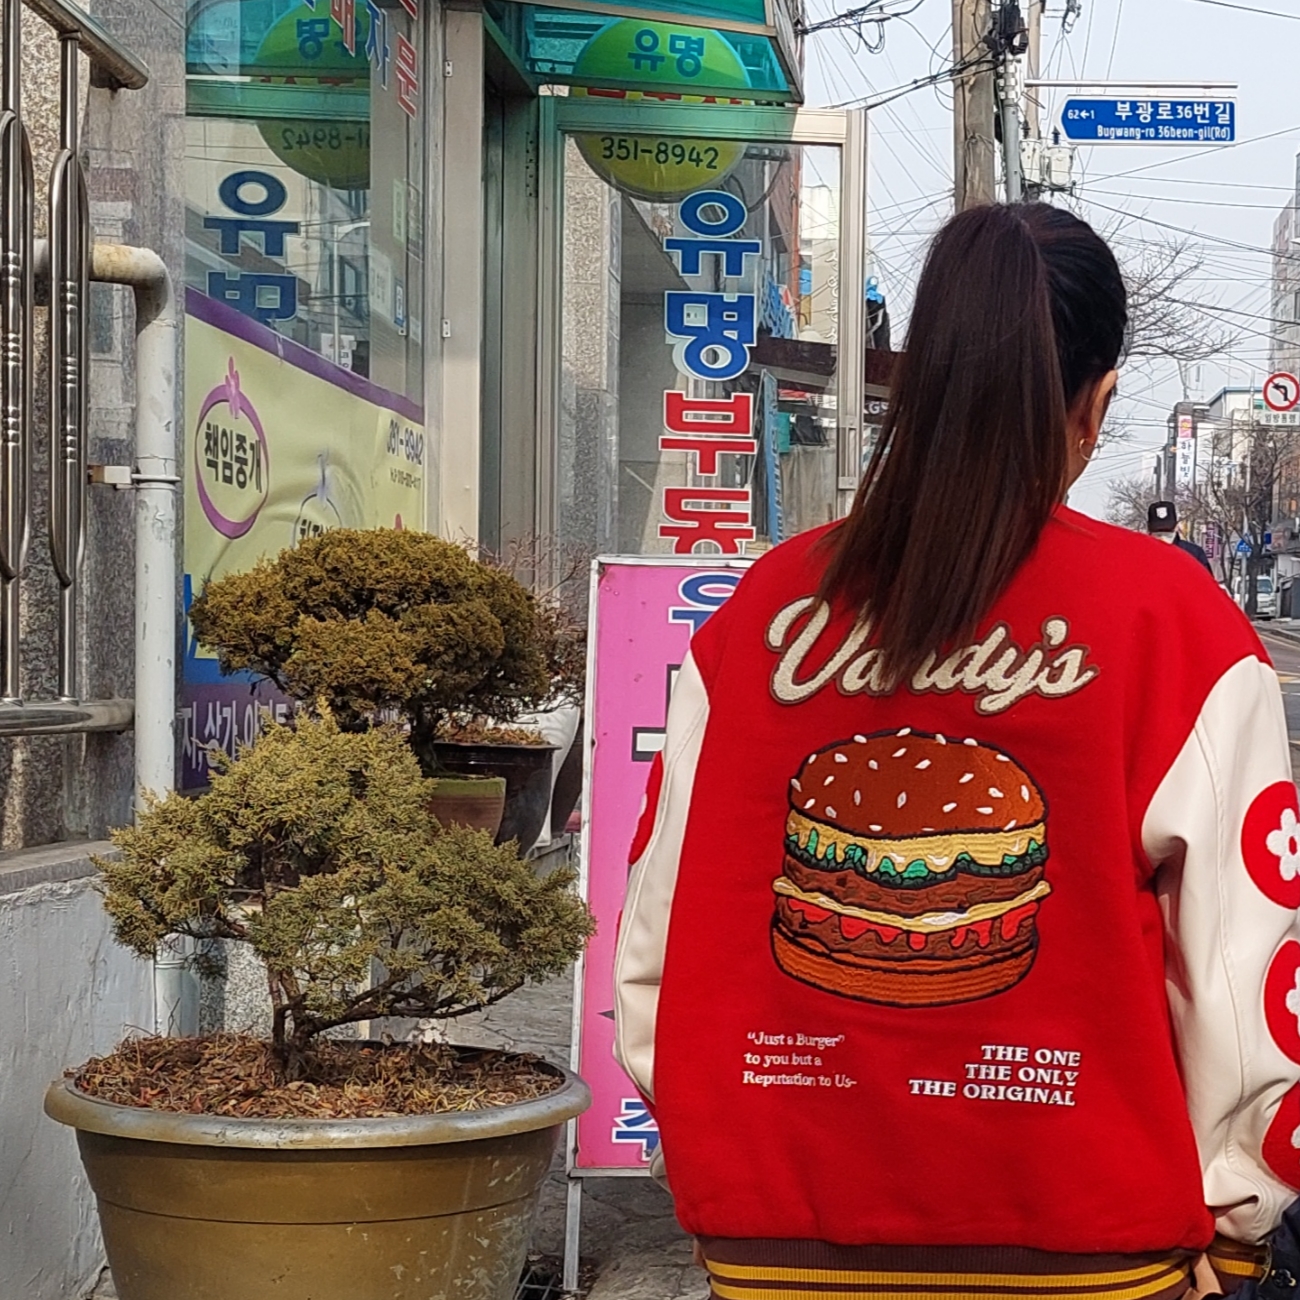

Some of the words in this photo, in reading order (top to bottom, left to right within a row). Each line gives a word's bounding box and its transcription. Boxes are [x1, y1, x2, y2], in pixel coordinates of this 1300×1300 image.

[628, 29, 705, 78] 유명
[1068, 109, 1080, 120] 62
[1115, 102, 1231, 125] 부광로36번길
[1097, 125, 1155, 139] Bugwang-ro
[1157, 126, 1231, 141] 36beon-gil(Rd)
[601, 136, 719, 170] 351-8942
[204, 421, 263, 493] 책임중개
[744, 1053, 760, 1066] to
[763, 1054, 790, 1068] you
[792, 1053, 813, 1066] but
[814, 1056, 822, 1066] a
[981, 1045, 1029, 1062] THE
[1034, 1048, 1082, 1067] ONE
[743, 1071, 817, 1087] Reputation
[818, 1074, 832, 1087] to
[965, 1064, 1012, 1081] THE
[1018, 1067, 1080, 1086] ONLY
[909, 1079, 957, 1097] THE
[962, 1084, 1077, 1107] ORIGINAL
